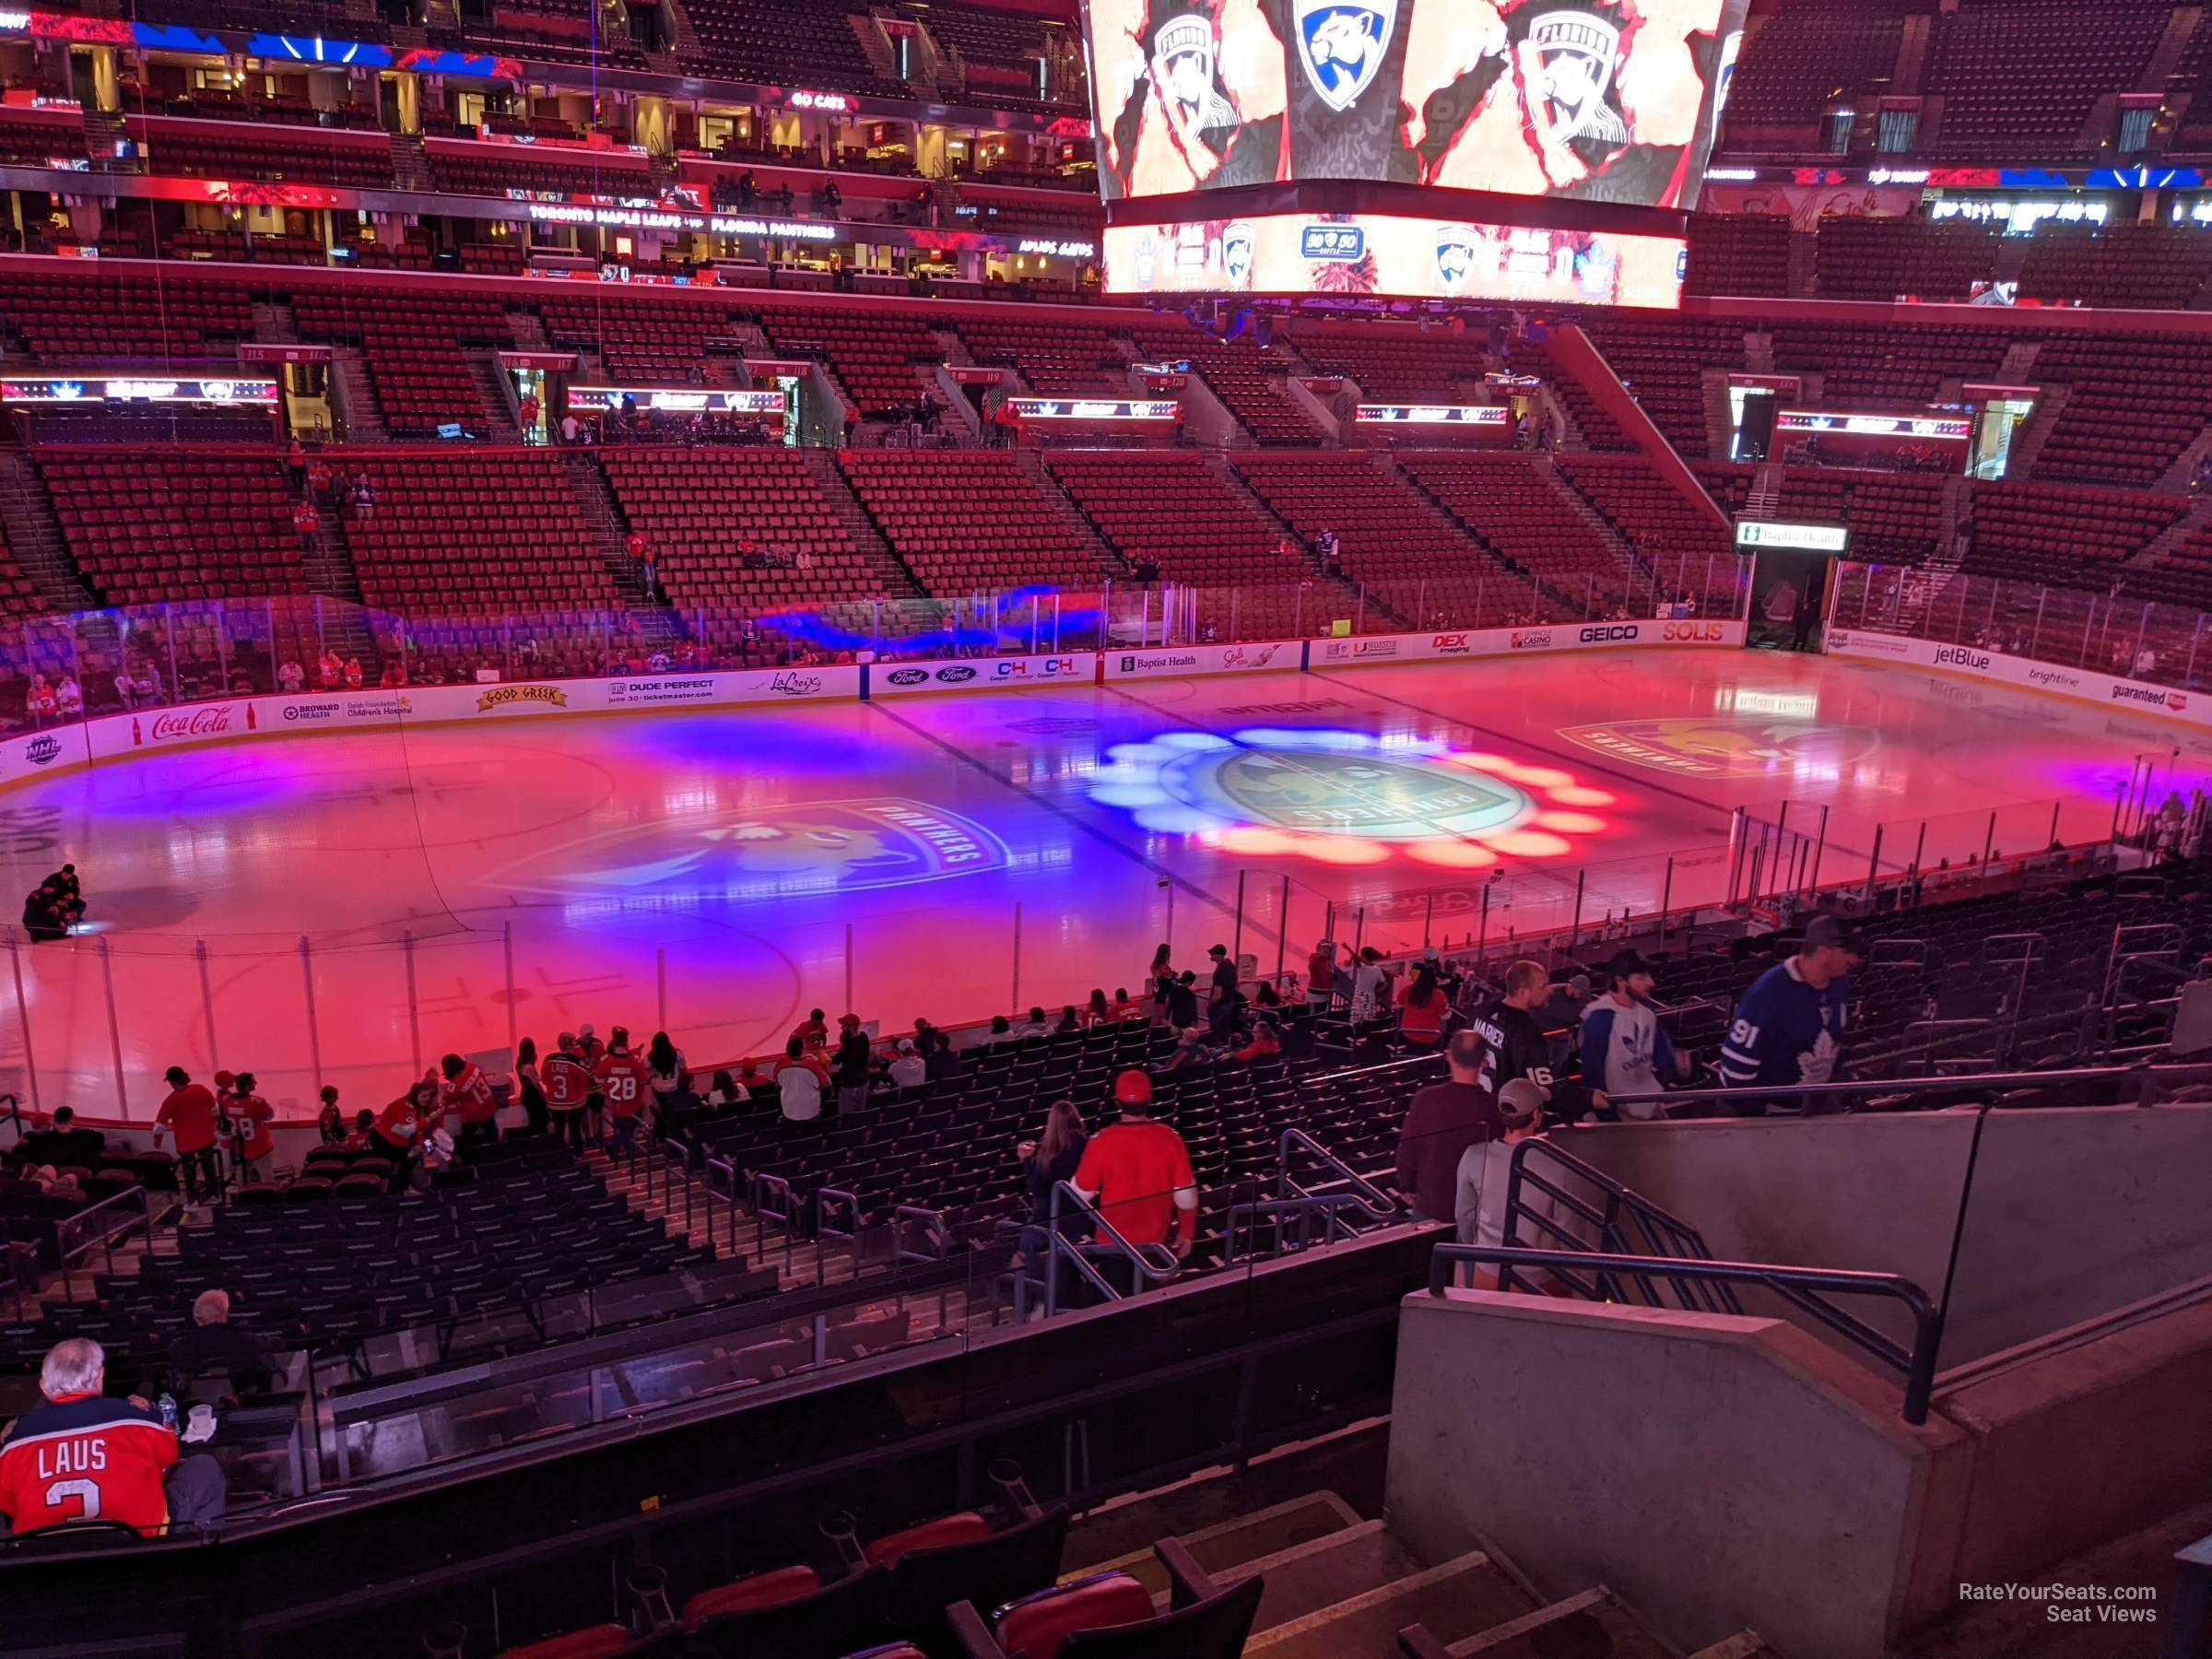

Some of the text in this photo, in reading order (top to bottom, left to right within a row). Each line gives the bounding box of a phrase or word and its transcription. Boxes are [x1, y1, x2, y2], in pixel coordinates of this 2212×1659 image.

[792, 93, 845, 110] GO CATS
[530, 206, 594, 222] TORONTO
[597, 210, 641, 225] MAPLE
[643, 214, 681, 228] LEAFS
[712, 218, 769, 235] FLORIDA
[770, 223, 836, 240] PANTHERS
[1524, 636, 1551, 644] CASINO
[1580, 626, 1638, 642] GEICO
[1663, 622, 1723, 641] SOLIS
[1431, 635, 1467, 648] DEX
[1137, 655, 1196, 669] Baptist Health
[1934, 645, 1990, 669] jetBlue
[893, 671, 923, 684] Ford
[942, 667, 971, 681] Ford
[2030, 669, 2079, 688] brightline
[486, 688, 558, 702] GOOD GREEK
[629, 682, 661, 691] DUDE
[665, 680, 714, 689] PERFECT
[2112, 685, 2166, 705] guaranteed
[643, 692, 712, 700] ticketmaster.com
[300, 704, 339, 712] BROWARD
[347, 707, 382, 716] Children's
[26, 740, 62, 759] NHL
[1583, 732, 1718, 771] PANTHERS
[863, 806, 982, 863] PANTHERS
[1730, 1019, 1759, 1048] 91
[1526, 1066, 1554, 1085] 16
[471, 1078, 493, 1105] 13
[553, 1075, 568, 1100] 3
[606, 1077, 637, 1100] 28
[38, 1439, 106, 1479] LAUS
